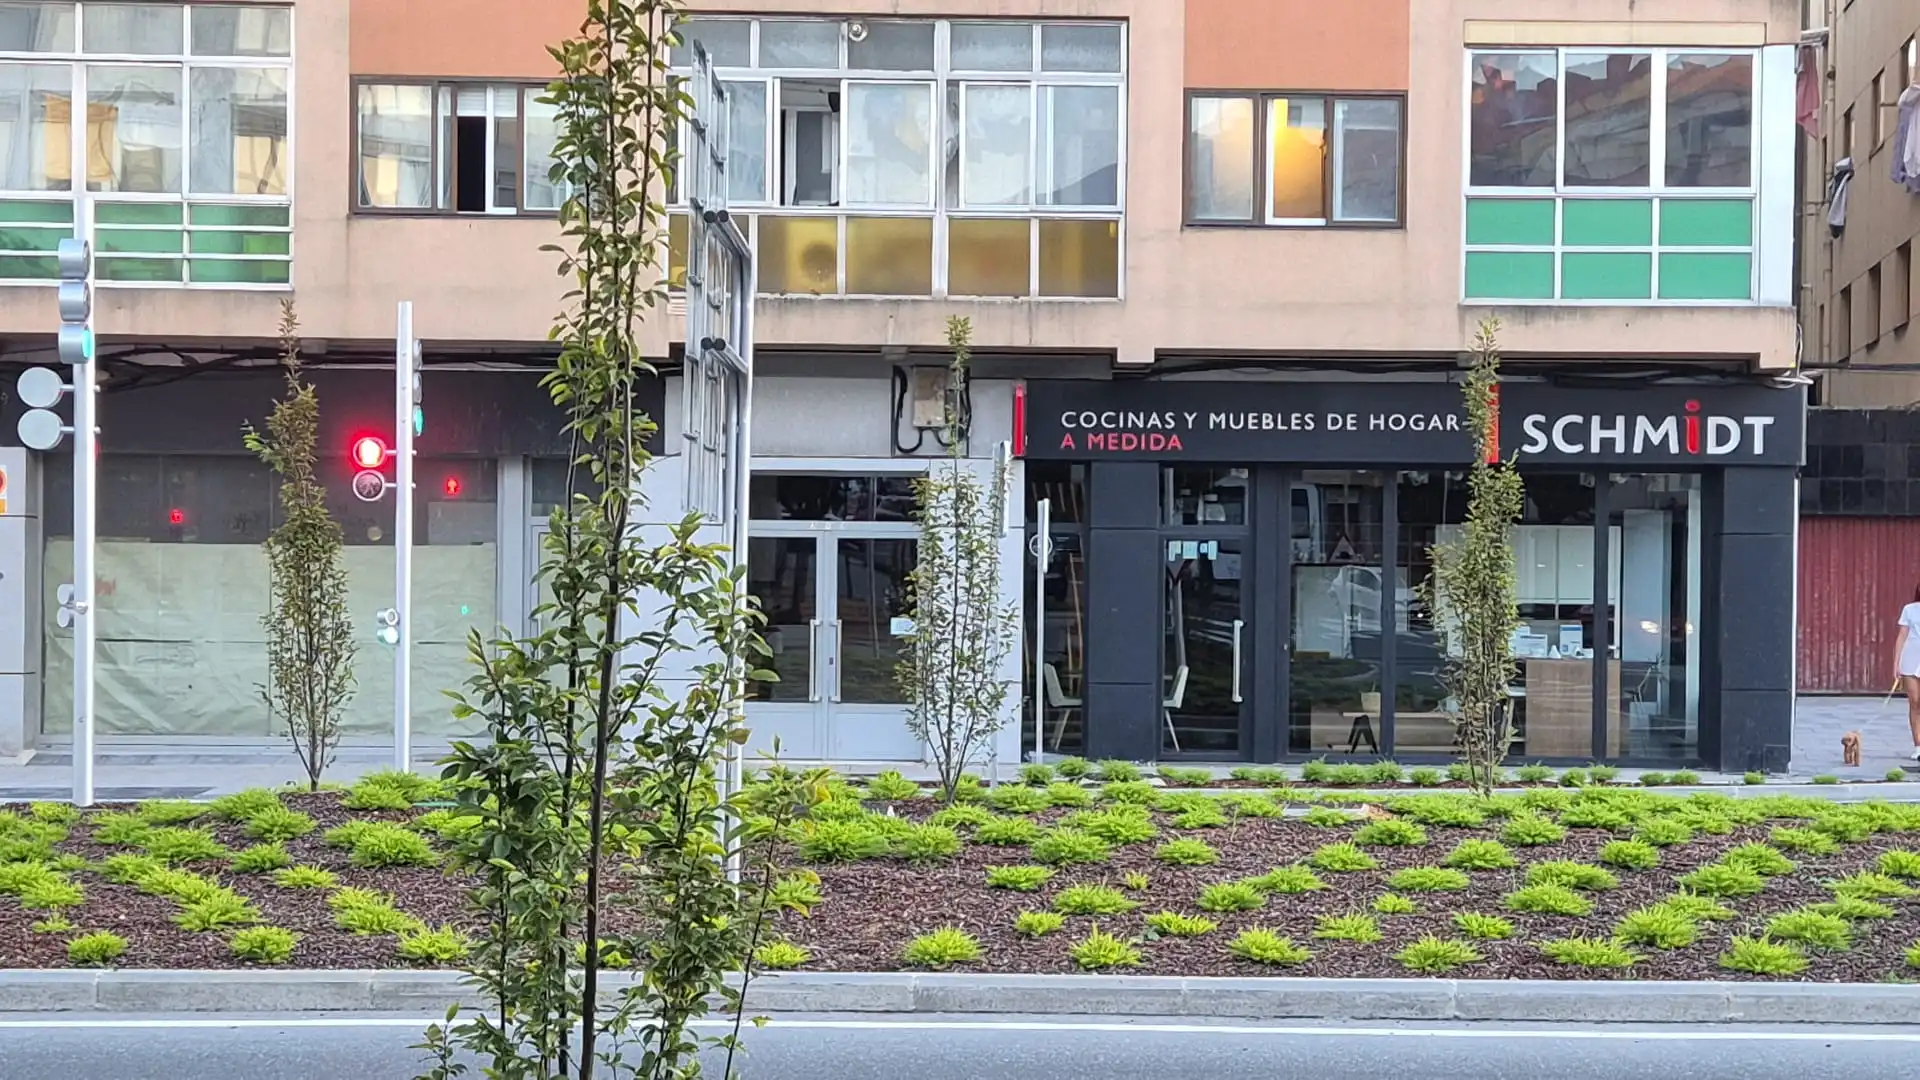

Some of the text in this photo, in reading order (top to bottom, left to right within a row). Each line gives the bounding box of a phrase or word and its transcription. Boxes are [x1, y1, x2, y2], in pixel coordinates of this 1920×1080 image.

[1060, 411, 1461, 431] COCINAS Y MUEBLES DE HOGAR
[1060, 433, 1183, 451] A MEDIDA
